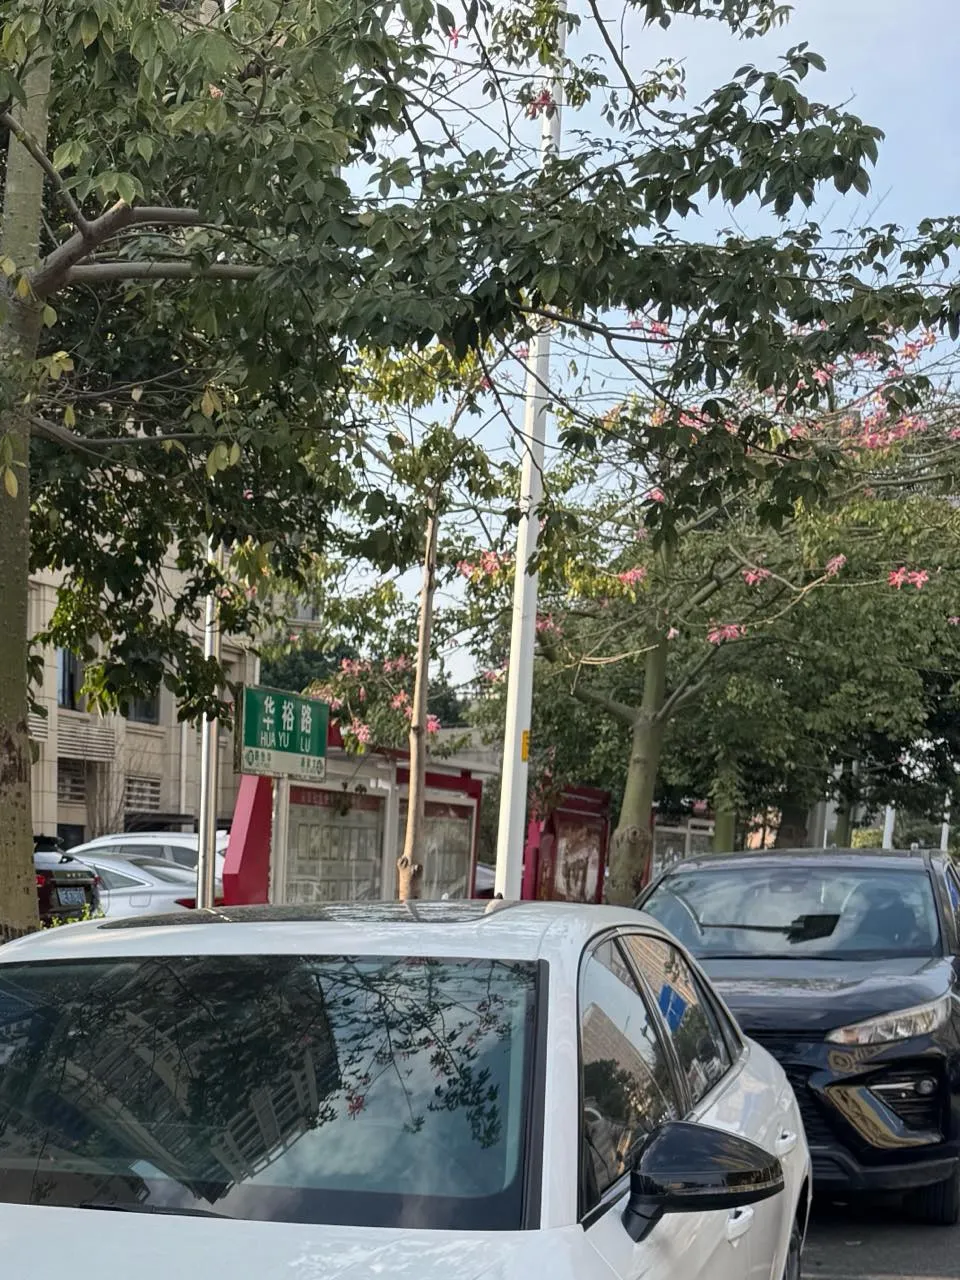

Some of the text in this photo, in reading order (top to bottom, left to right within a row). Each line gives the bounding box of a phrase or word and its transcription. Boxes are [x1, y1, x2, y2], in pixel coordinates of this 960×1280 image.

[262, 696, 312, 734] 华裕路
[260, 731, 311, 753] HUA YU LU
